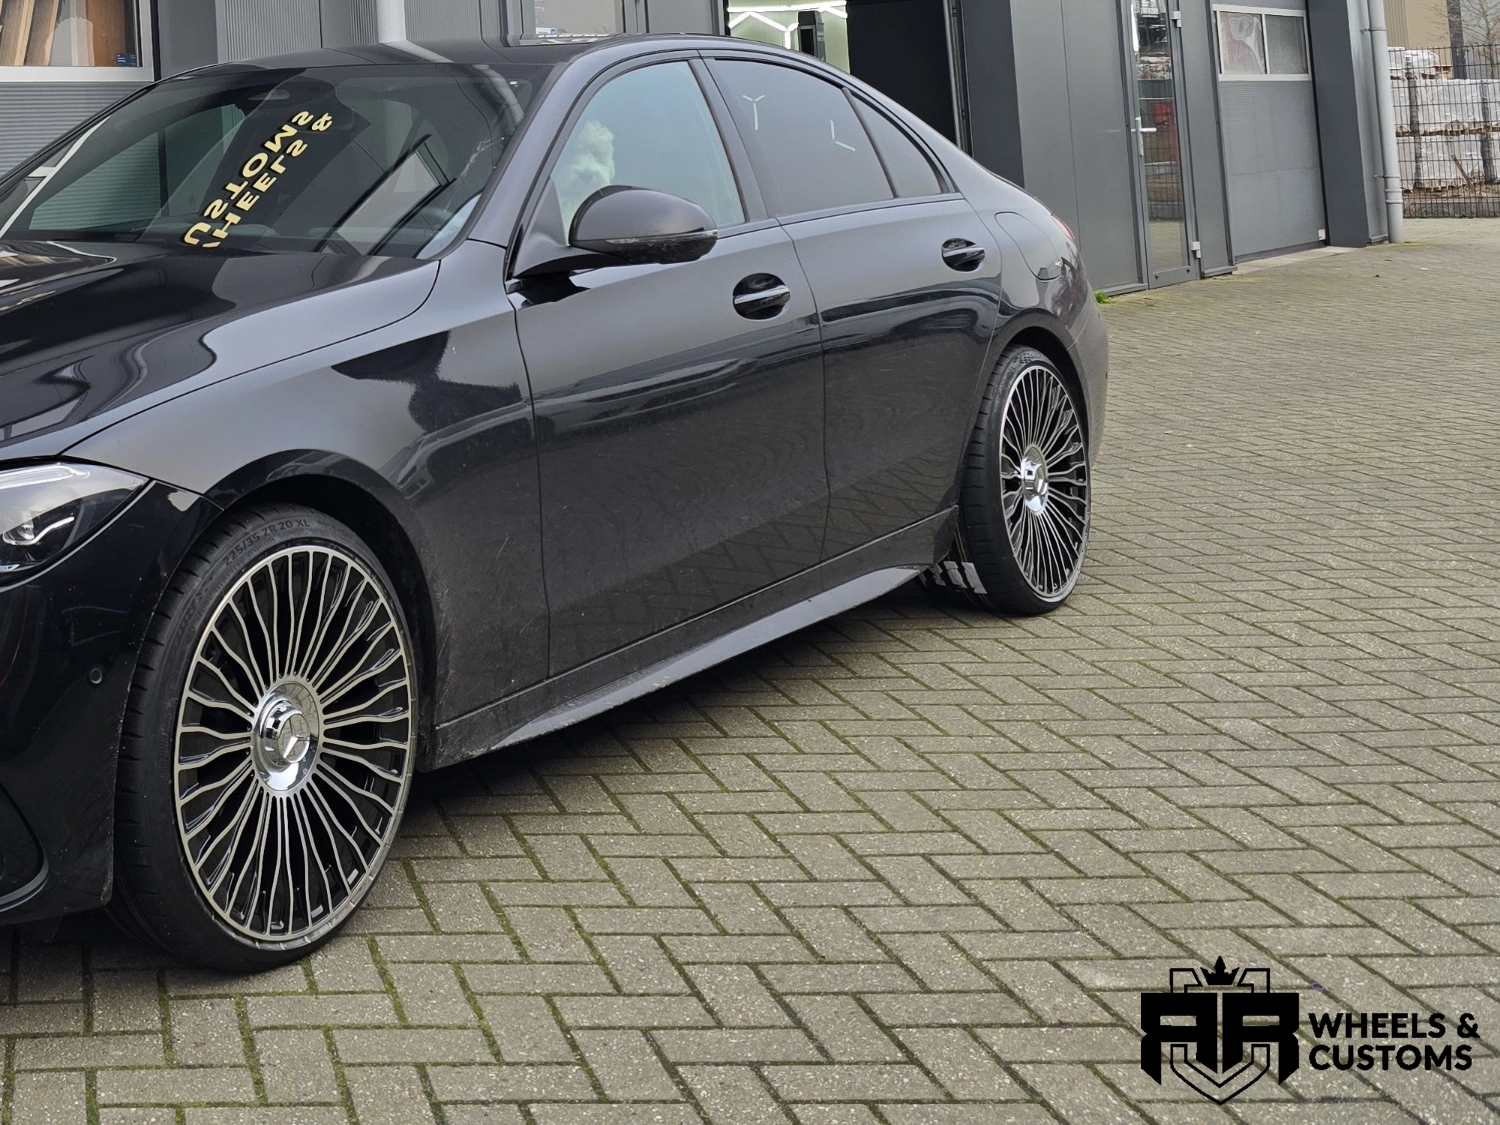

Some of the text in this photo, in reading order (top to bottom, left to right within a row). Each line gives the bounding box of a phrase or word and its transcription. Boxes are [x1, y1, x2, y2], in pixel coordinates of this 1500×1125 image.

[222, 518, 311, 568] 225/35 ZR 20 XL
